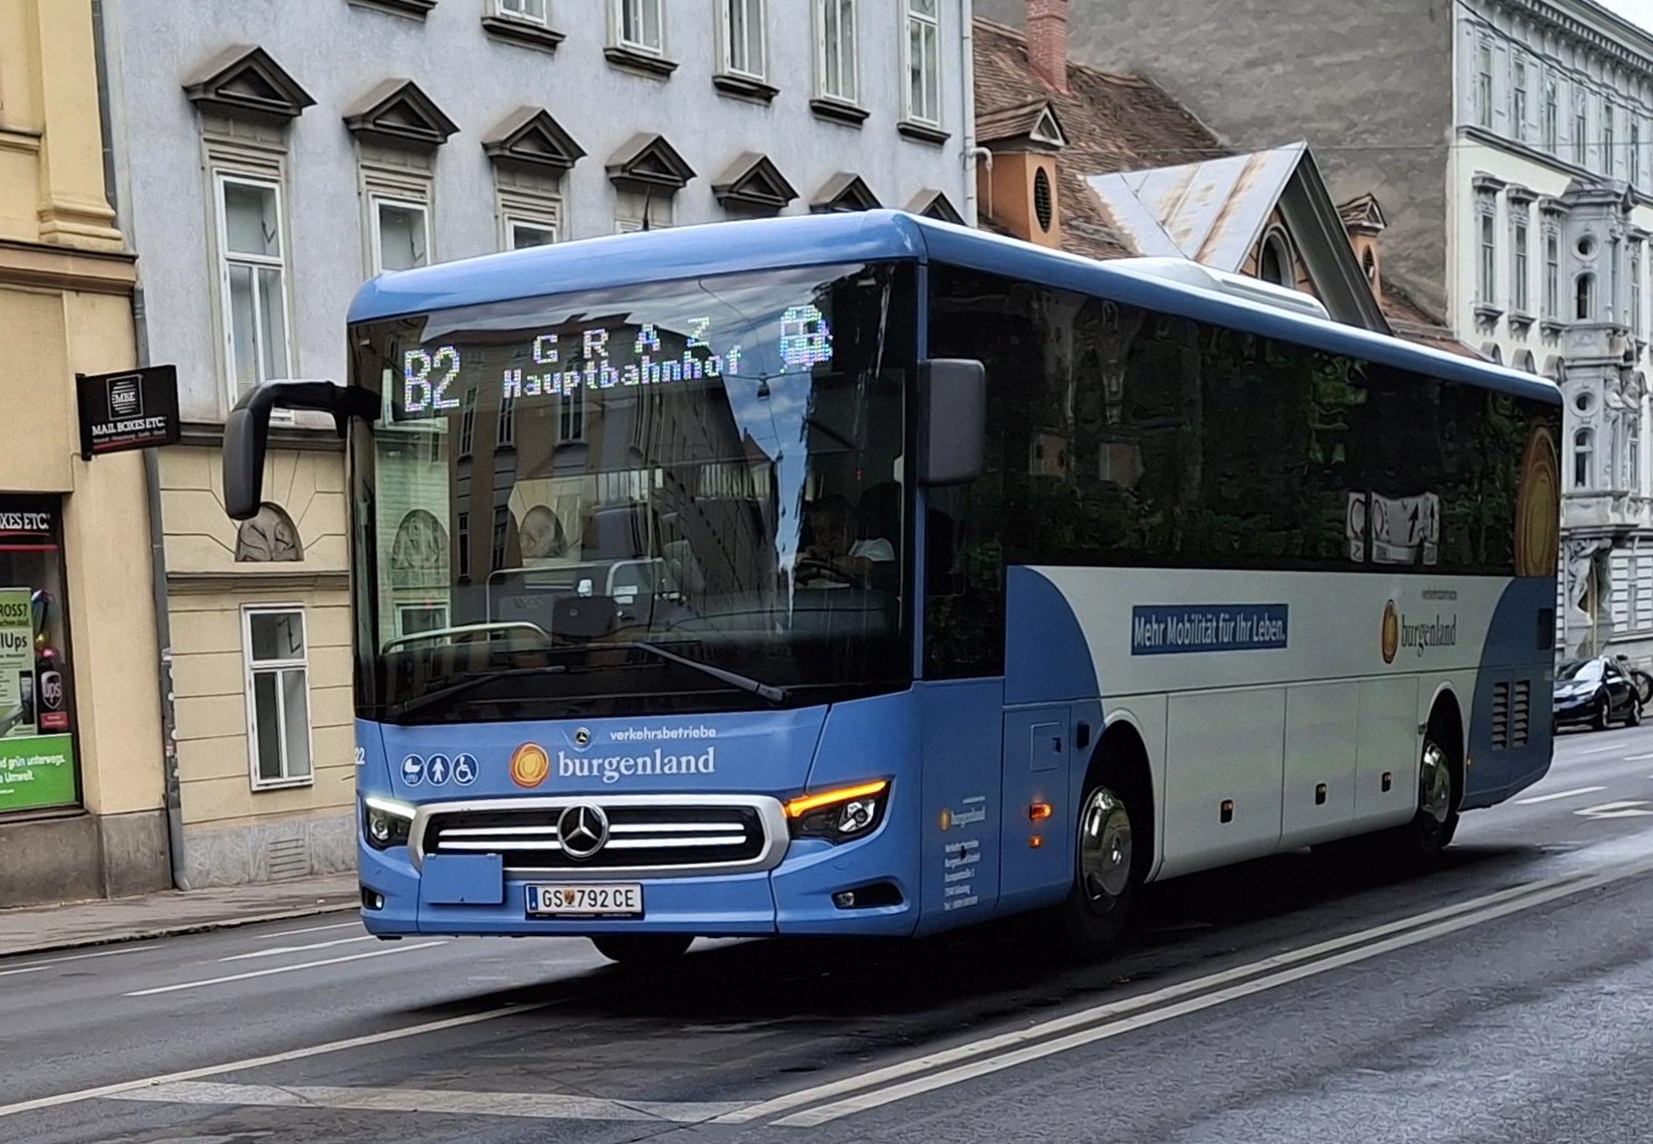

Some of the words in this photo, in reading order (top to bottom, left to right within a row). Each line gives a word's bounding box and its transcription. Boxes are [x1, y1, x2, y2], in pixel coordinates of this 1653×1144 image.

[404, 345, 461, 412] B2
[503, 344, 741, 398] Hauptbahnhof
[91, 423, 116, 436] MAIL
[116, 419, 145, 432] BOXES
[1134, 614, 1165, 647] Mehr
[1167, 612, 1217, 645] Mobilität
[1218, 612, 1235, 643] für
[1235, 612, 1252, 643] Ihr
[1252, 612, 1286, 642] Leben.
[1401, 613, 1457, 658] burgenland
[610, 725, 717, 741] verkehrsbetriebe
[558, 746, 716, 784] burgenland
[542, 889, 563, 908] GS
[576, 889, 609, 908] 792
[613, 889, 635, 908] CE
